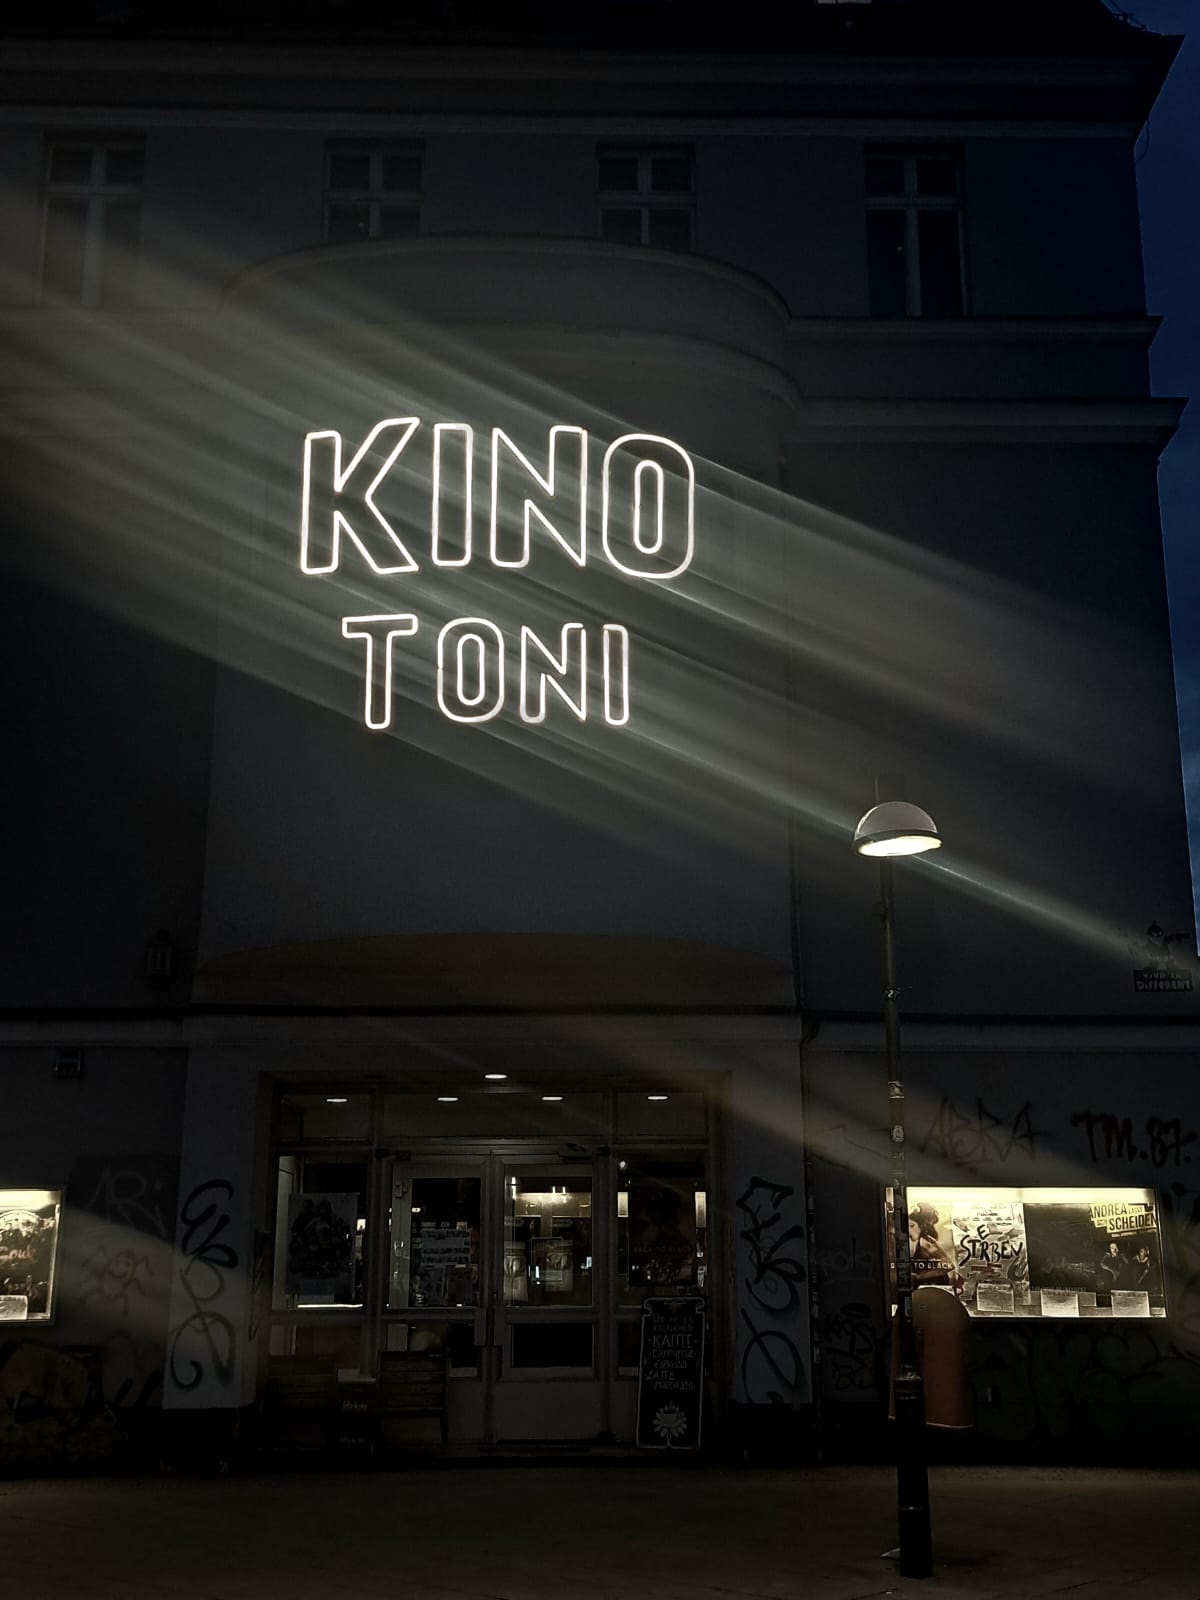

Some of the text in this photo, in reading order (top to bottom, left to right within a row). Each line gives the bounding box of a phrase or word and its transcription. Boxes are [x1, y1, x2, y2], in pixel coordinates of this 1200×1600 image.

[300, 416, 695, 580] KINO
[341, 612, 631, 730] TONI
[1089, 1203, 1128, 1219] ANDREA
[1108, 1212, 1157, 1231] SCHEIDEN
